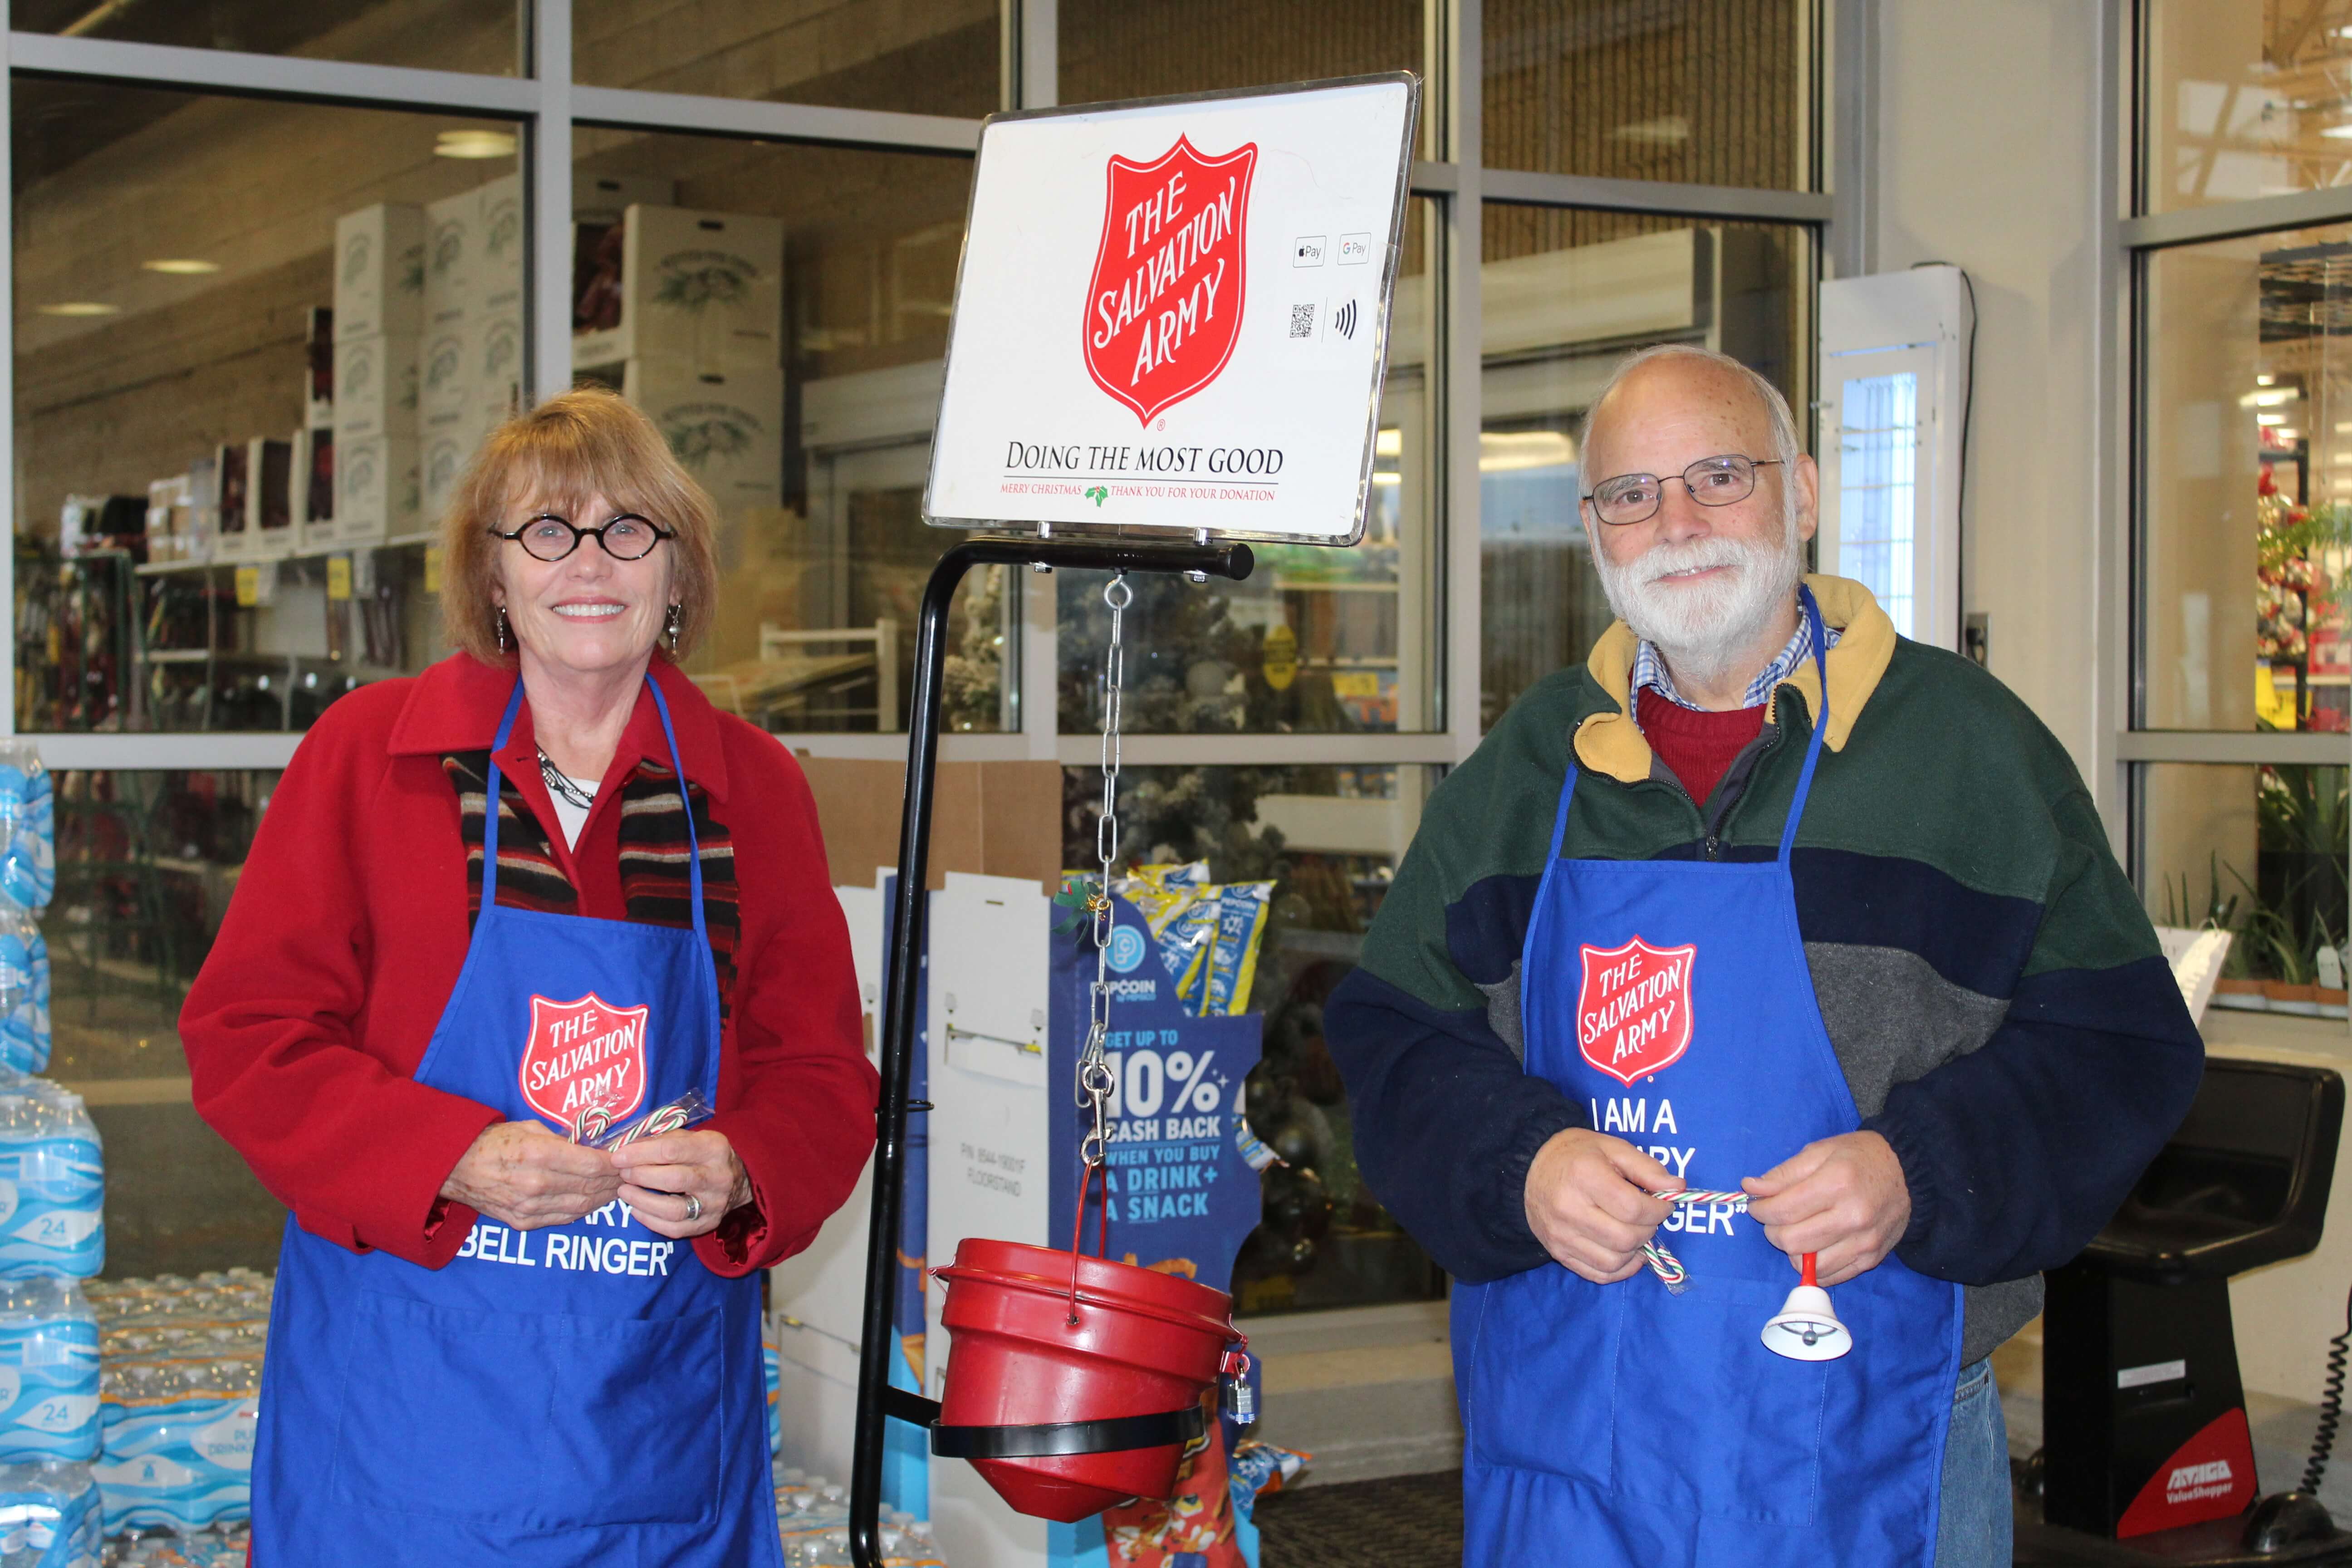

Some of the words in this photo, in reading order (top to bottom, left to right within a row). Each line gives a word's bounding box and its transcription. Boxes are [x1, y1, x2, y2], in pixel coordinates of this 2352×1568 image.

[1125, 171, 1186, 259] THE
[1093, 176, 1235, 349] SALVATION
[1305, 245, 1321, 260] Pay
[1352, 242, 1367, 256] Pay
[1131, 258, 1225, 387] ARMY
[1005, 441, 1081, 470] DOING
[1088, 446, 1131, 470] THE
[1135, 446, 1203, 472] MOST
[1209, 448, 1284, 474] GOOD
[1000, 483, 1030, 494] MERRY
[1031, 484, 1082, 495] CHRISTMAS
[1111, 485, 1143, 497] THANK
[1145, 486, 1165, 497] YOU
[1168, 487, 1186, 498] FOR
[1190, 488, 1216, 500] YOUR
[1220, 489, 1275, 501] DONATION
[1599, 953, 1642, 997] THE
[1584, 959, 1681, 1044] SALVATION
[549, 1009, 598, 1048] THE
[1105, 1031, 1132, 1048] GET
[1136, 1030, 1156, 1046] UP
[1160, 1029, 1178, 1045] TO
[1612, 1000, 1675, 1065] ARMY
[529, 1018, 636, 1090] SALVATION
[561, 1058, 631, 1113] ARMY
[1104, 1049, 1220, 1118] 10%
[1106, 1119, 1159, 1143] CASH
[1166, 1115, 1220, 1140] BACK
[1604, 1098, 1646, 1132] AM
[1652, 1098, 1678, 1134] A
[1105, 1149, 1148, 1166] WHEN
[1154, 1147, 1184, 1163] YOU
[1190, 1145, 1220, 1161] BUY
[1106, 1170, 1118, 1192] A
[1106, 1198, 1118, 1221] A
[1127, 1192, 1209, 1220] SNACK
[40, 1218, 65, 1235] 24
[456, 1225, 536, 1266] BELL
[43, 1403, 69, 1421] 24
[2167, 1482, 2233, 1505] ValueShopper
